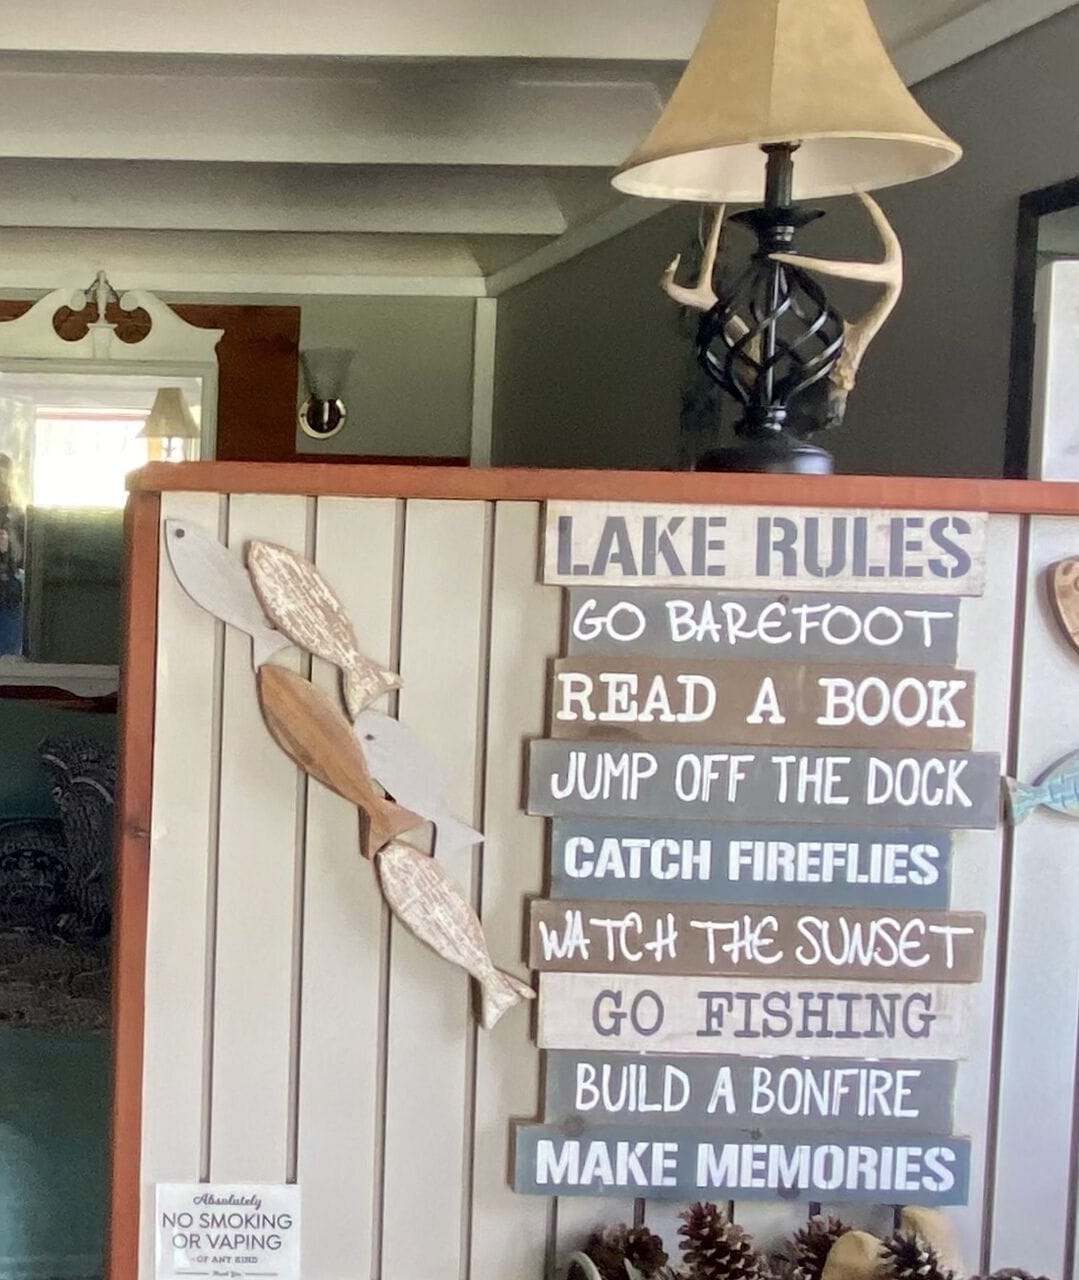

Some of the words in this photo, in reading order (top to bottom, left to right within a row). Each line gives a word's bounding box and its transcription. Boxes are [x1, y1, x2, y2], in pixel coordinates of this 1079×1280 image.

[556, 516, 727, 577] LAKE
[755, 516, 972, 579] RULES
[572, 599, 646, 641] GO
[665, 600, 954, 648] BAREFOOT
[556, 672, 717, 723] READ
[746, 677, 786, 724] A
[817, 677, 967, 729] BOOK
[550, 751, 658, 800] JUMP
[675, 754, 755, 803] OFF
[770, 755, 851, 806] THE
[866, 757, 973, 808] DOCK
[564, 837, 712, 880] CATCH
[728, 841, 940, 886] FIREFLIES
[538, 910, 678, 962] WATCH
[690, 915, 783, 965] THE
[795, 917, 974, 969] SUNSET
[592, 989, 665, 1037] GO
[696, 991, 937, 1039] FISHING
[575, 1063, 690, 1113] BUILD
[707, 1066, 736, 1114] A
[751, 1067, 921, 1118] BONFIRE
[535, 1139, 679, 1187] MAKE
[696, 1142, 957, 1193] MEMORIES
[162, 1212, 194, 1229] NO
[199, 1212, 293, 1230] SMOKING
[192, 1193, 263, 1211] Absolutely
[172, 1233, 201, 1250] OR
[206, 1233, 282, 1251] VAPING
